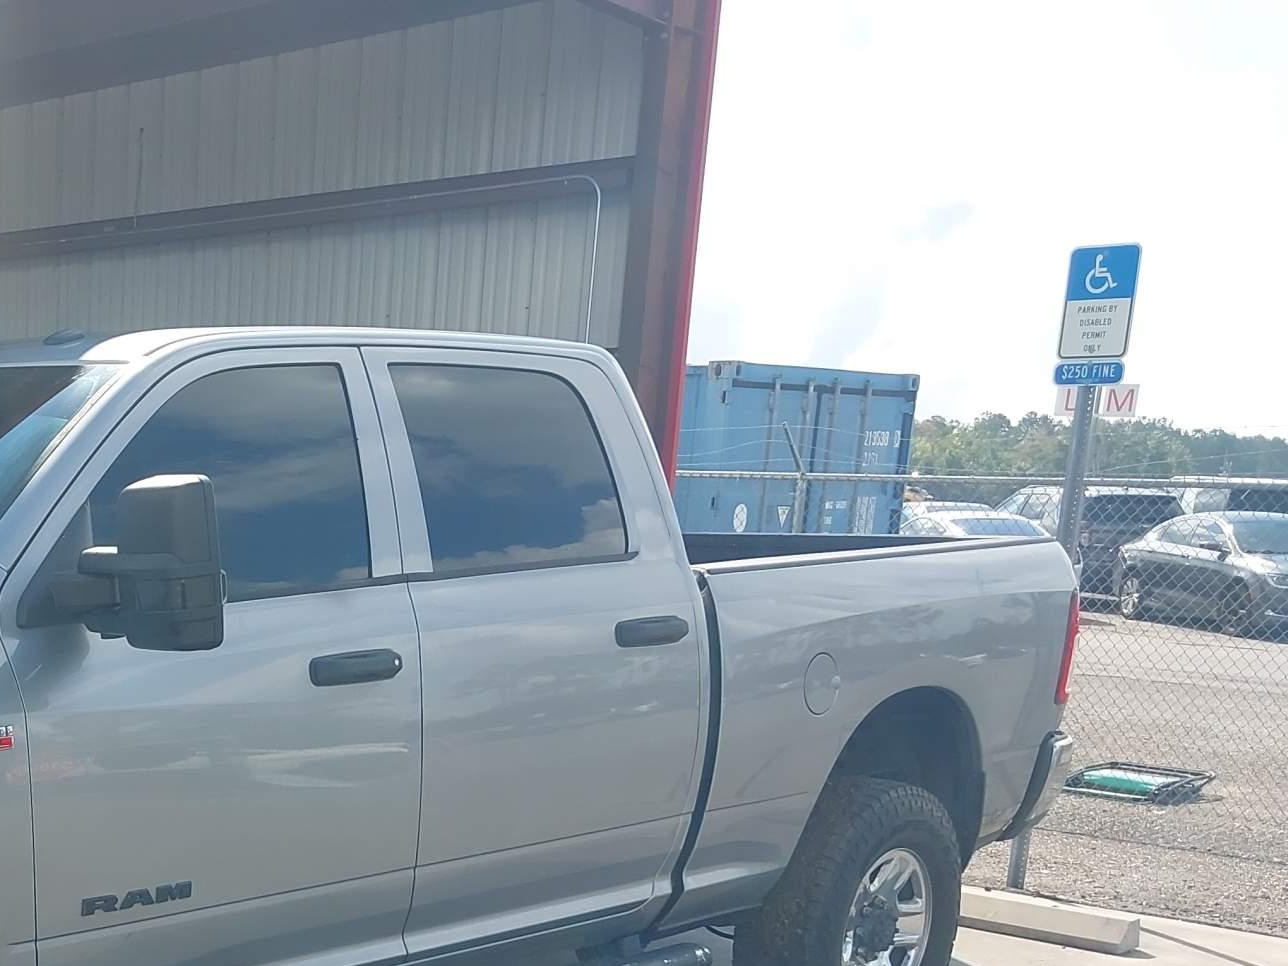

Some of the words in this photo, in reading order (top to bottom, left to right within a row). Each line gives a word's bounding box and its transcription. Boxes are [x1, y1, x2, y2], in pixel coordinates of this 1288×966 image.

[1077, 305, 1107, 314] PARKING
[1108, 304, 1118, 313] BY
[1079, 318, 1112, 327] DISABLED
[1081, 331, 1106, 339] PERMIT
[1083, 344, 1101, 352] ONLY
[1061, 365, 1088, 380] $250
[1091, 364, 1116, 378] FINE
[1106, 388, 1135, 412] M
[81, 880, 192, 917] RAM
